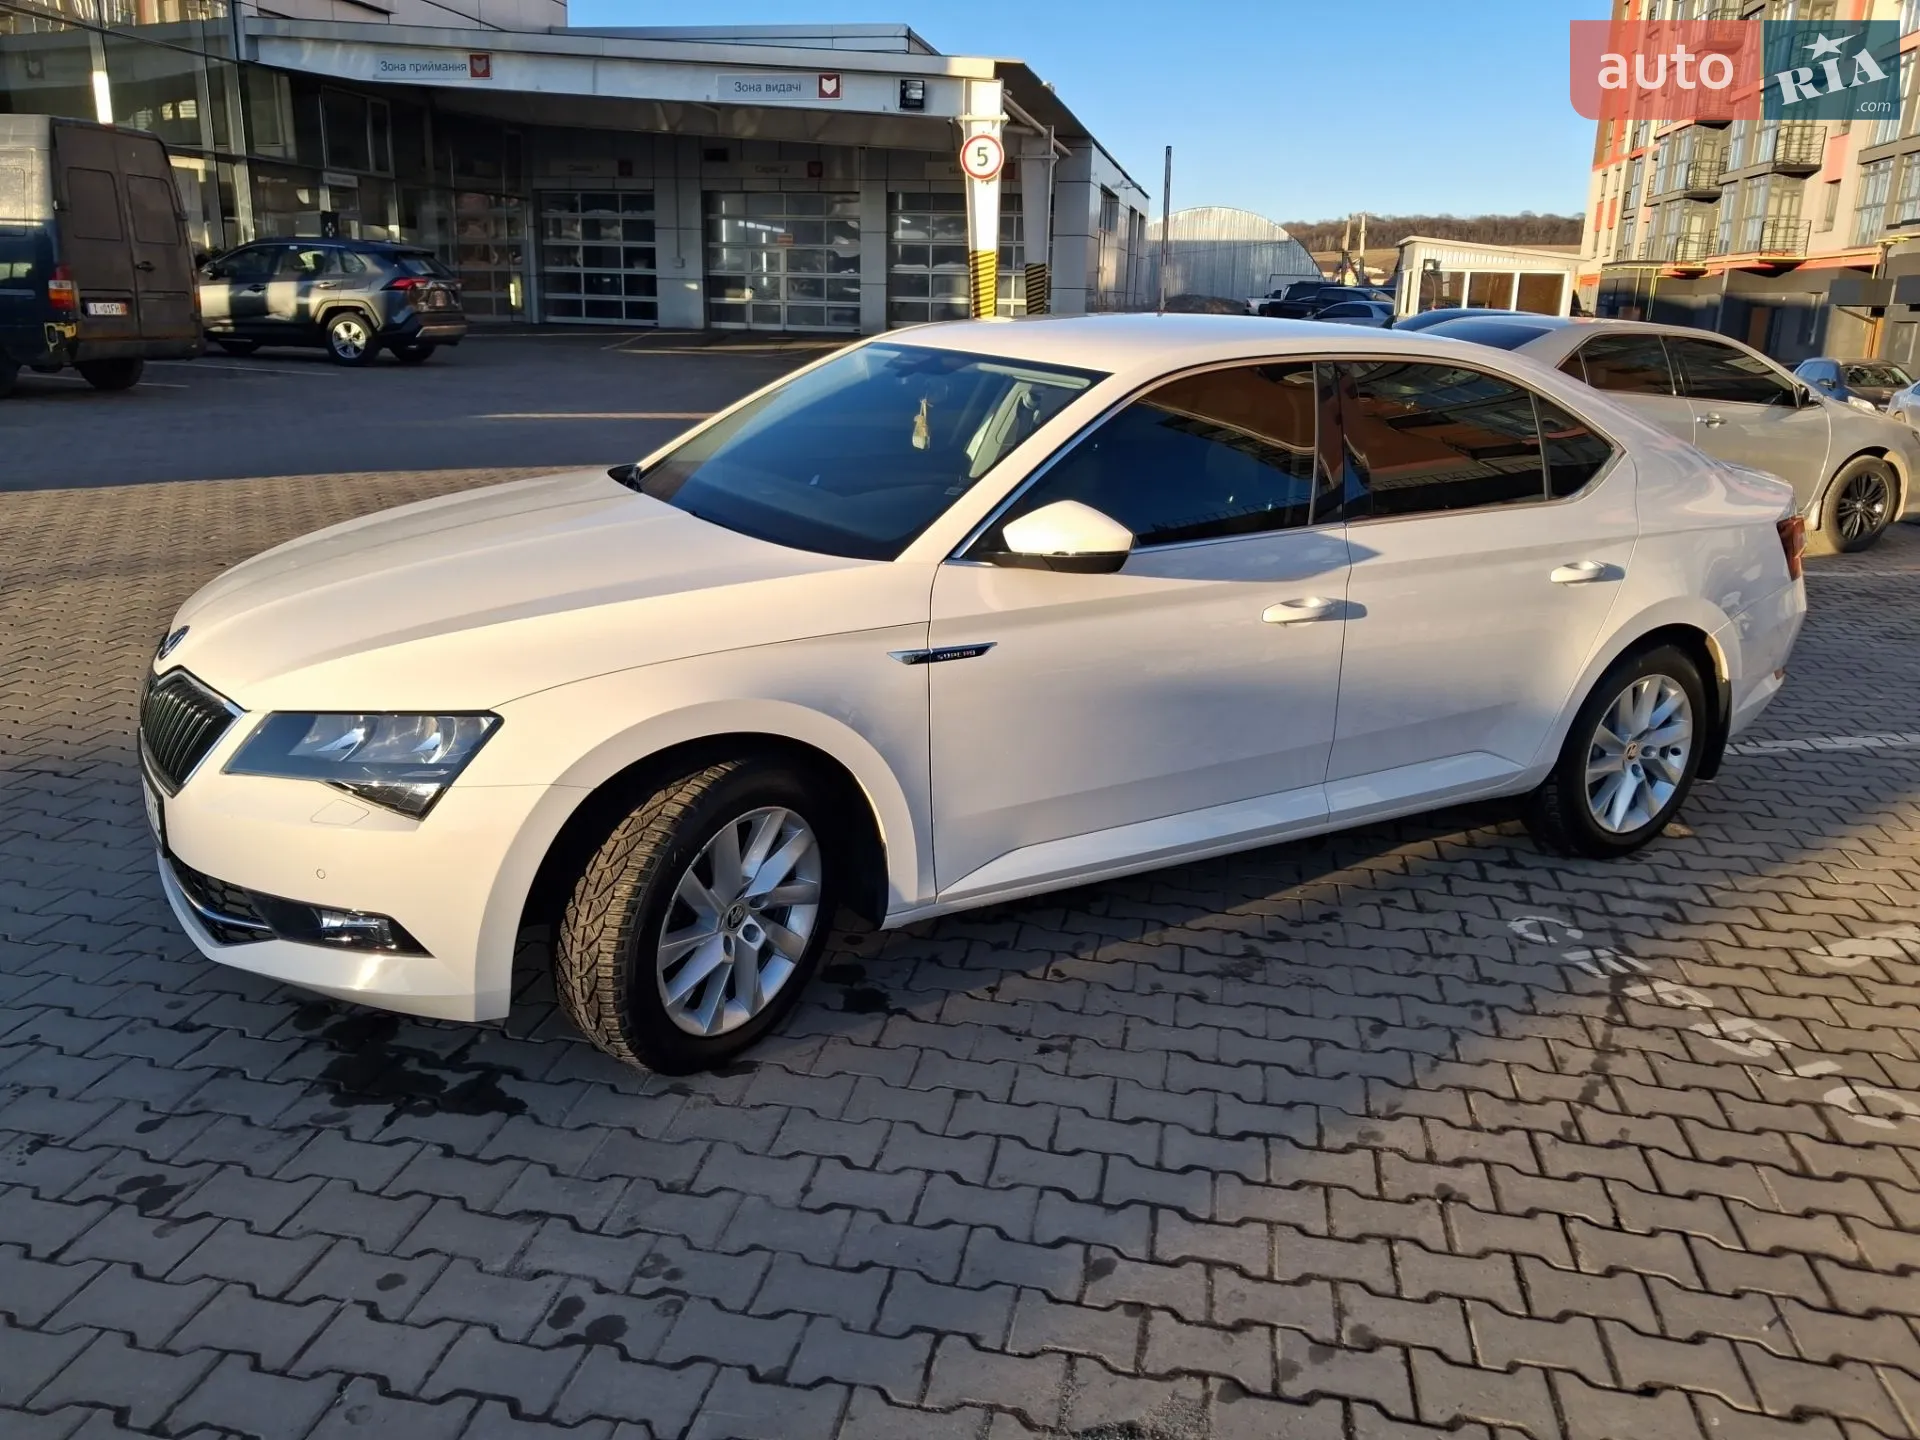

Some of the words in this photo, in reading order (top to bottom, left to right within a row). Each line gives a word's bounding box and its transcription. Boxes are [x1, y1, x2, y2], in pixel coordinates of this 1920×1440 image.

[380, 60, 407, 72] Зона
[409, 61, 467, 74] приймання
[734, 81, 762, 93] Зона
[765, 82, 802, 95] видачі
[976, 146, 989, 167] 5
